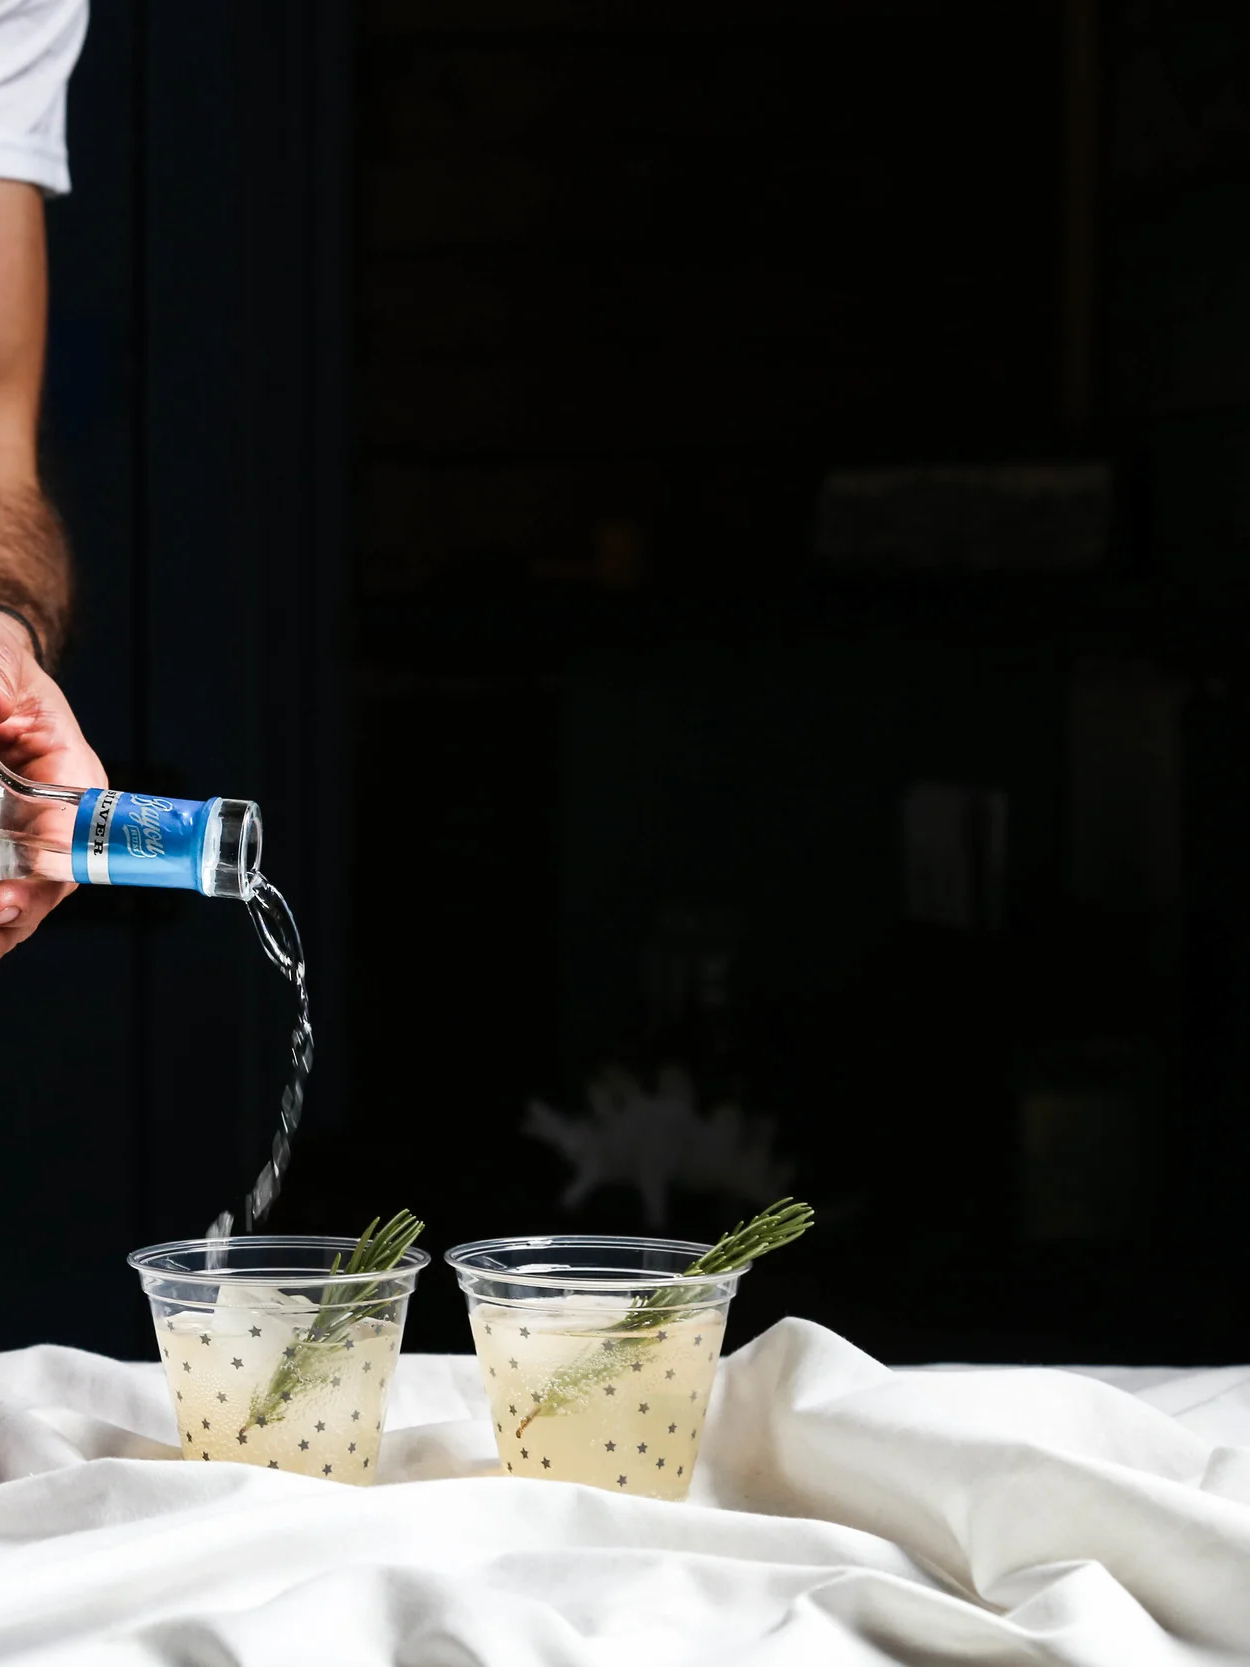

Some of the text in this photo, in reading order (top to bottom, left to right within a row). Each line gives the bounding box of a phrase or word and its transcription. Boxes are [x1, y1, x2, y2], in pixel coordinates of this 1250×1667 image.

[93, 790, 117, 856] SILVER
[129, 794, 173, 858] Bayou
[132, 828, 140, 853] RUM
